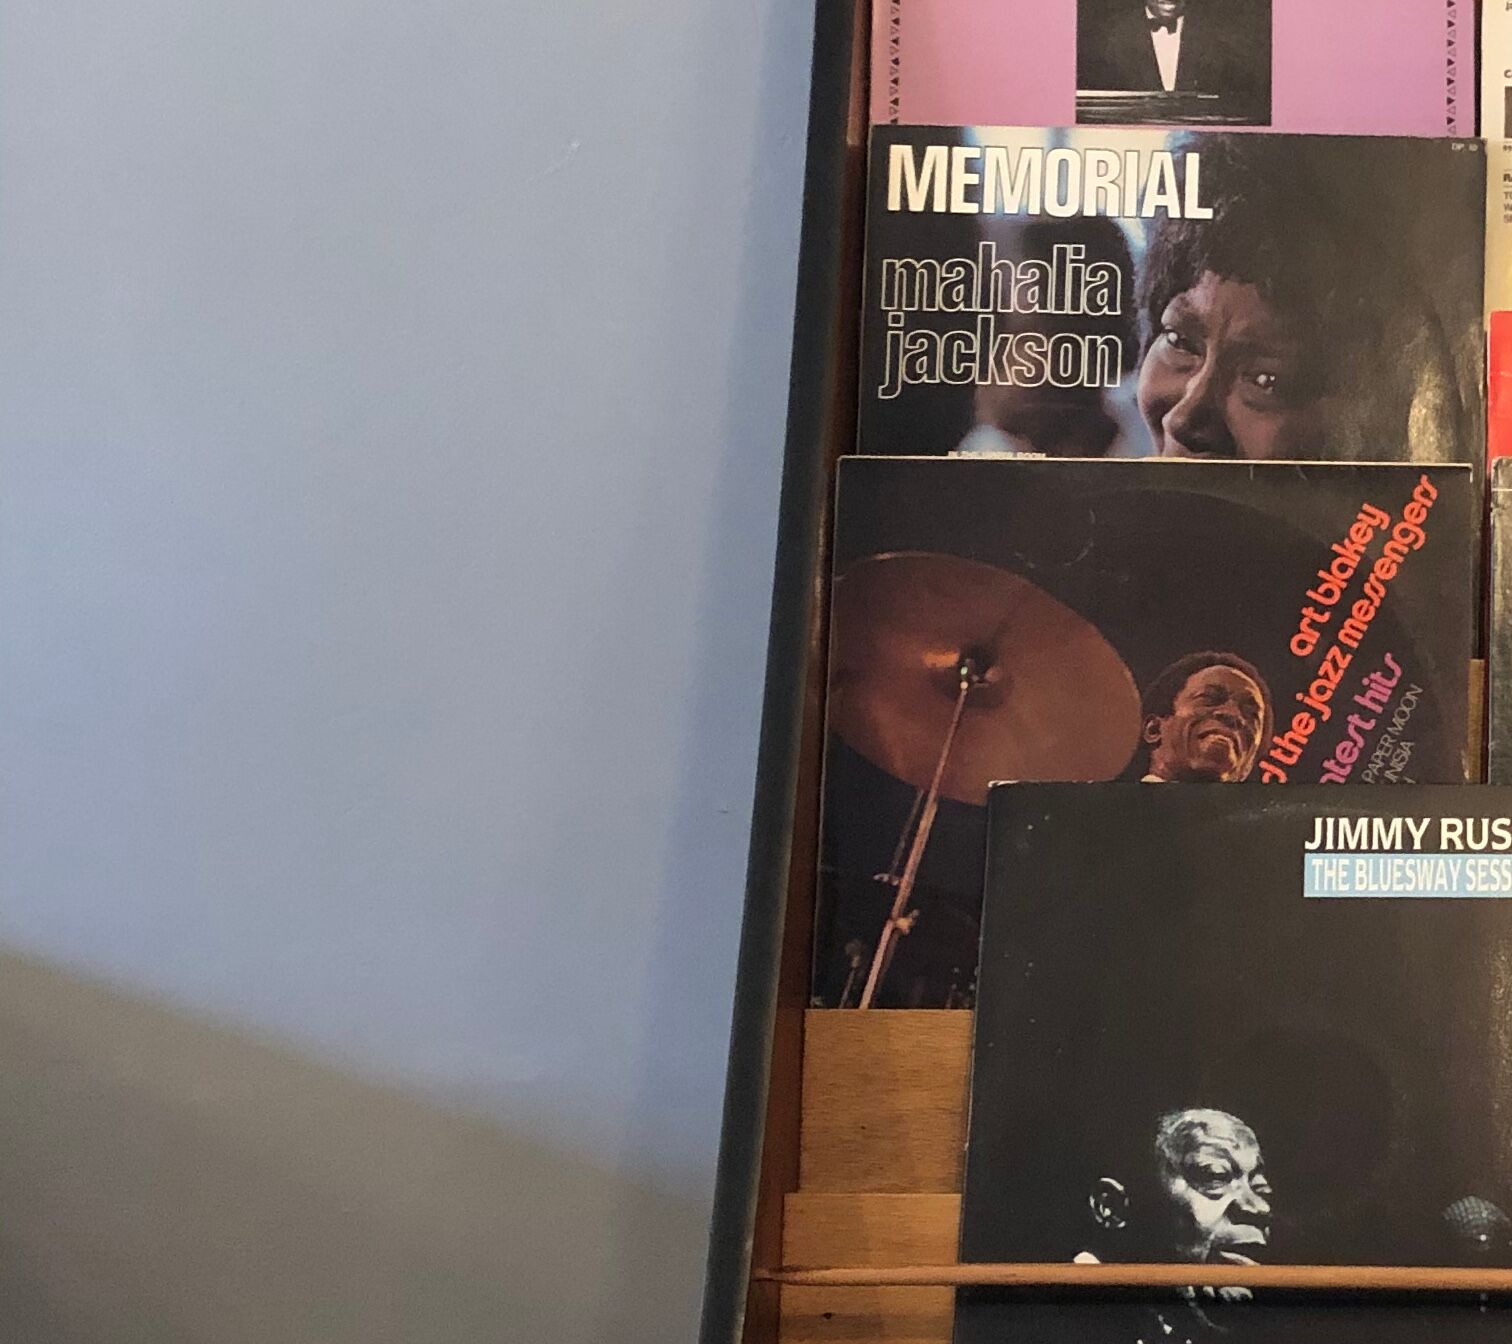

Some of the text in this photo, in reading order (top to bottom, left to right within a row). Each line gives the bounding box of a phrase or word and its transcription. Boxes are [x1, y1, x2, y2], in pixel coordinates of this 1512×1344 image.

[887, 144, 1214, 220] MEMORIAL
[880, 241, 1122, 315] mahalia
[878, 312, 1122, 399] jackson
[1290, 502, 1391, 656] art blakey
[1269, 711, 1317, 766] the
[1295, 644, 1353, 722] jazz
[1338, 474, 1438, 649] messengers
[1353, 652, 1402, 714] hits
[1361, 683, 1424, 784] PAPER MOON
[1304, 816, 1431, 851] JIMMY
[1311, 858, 1350, 892] THE
[1354, 858, 1460, 892] BLUESWAY
